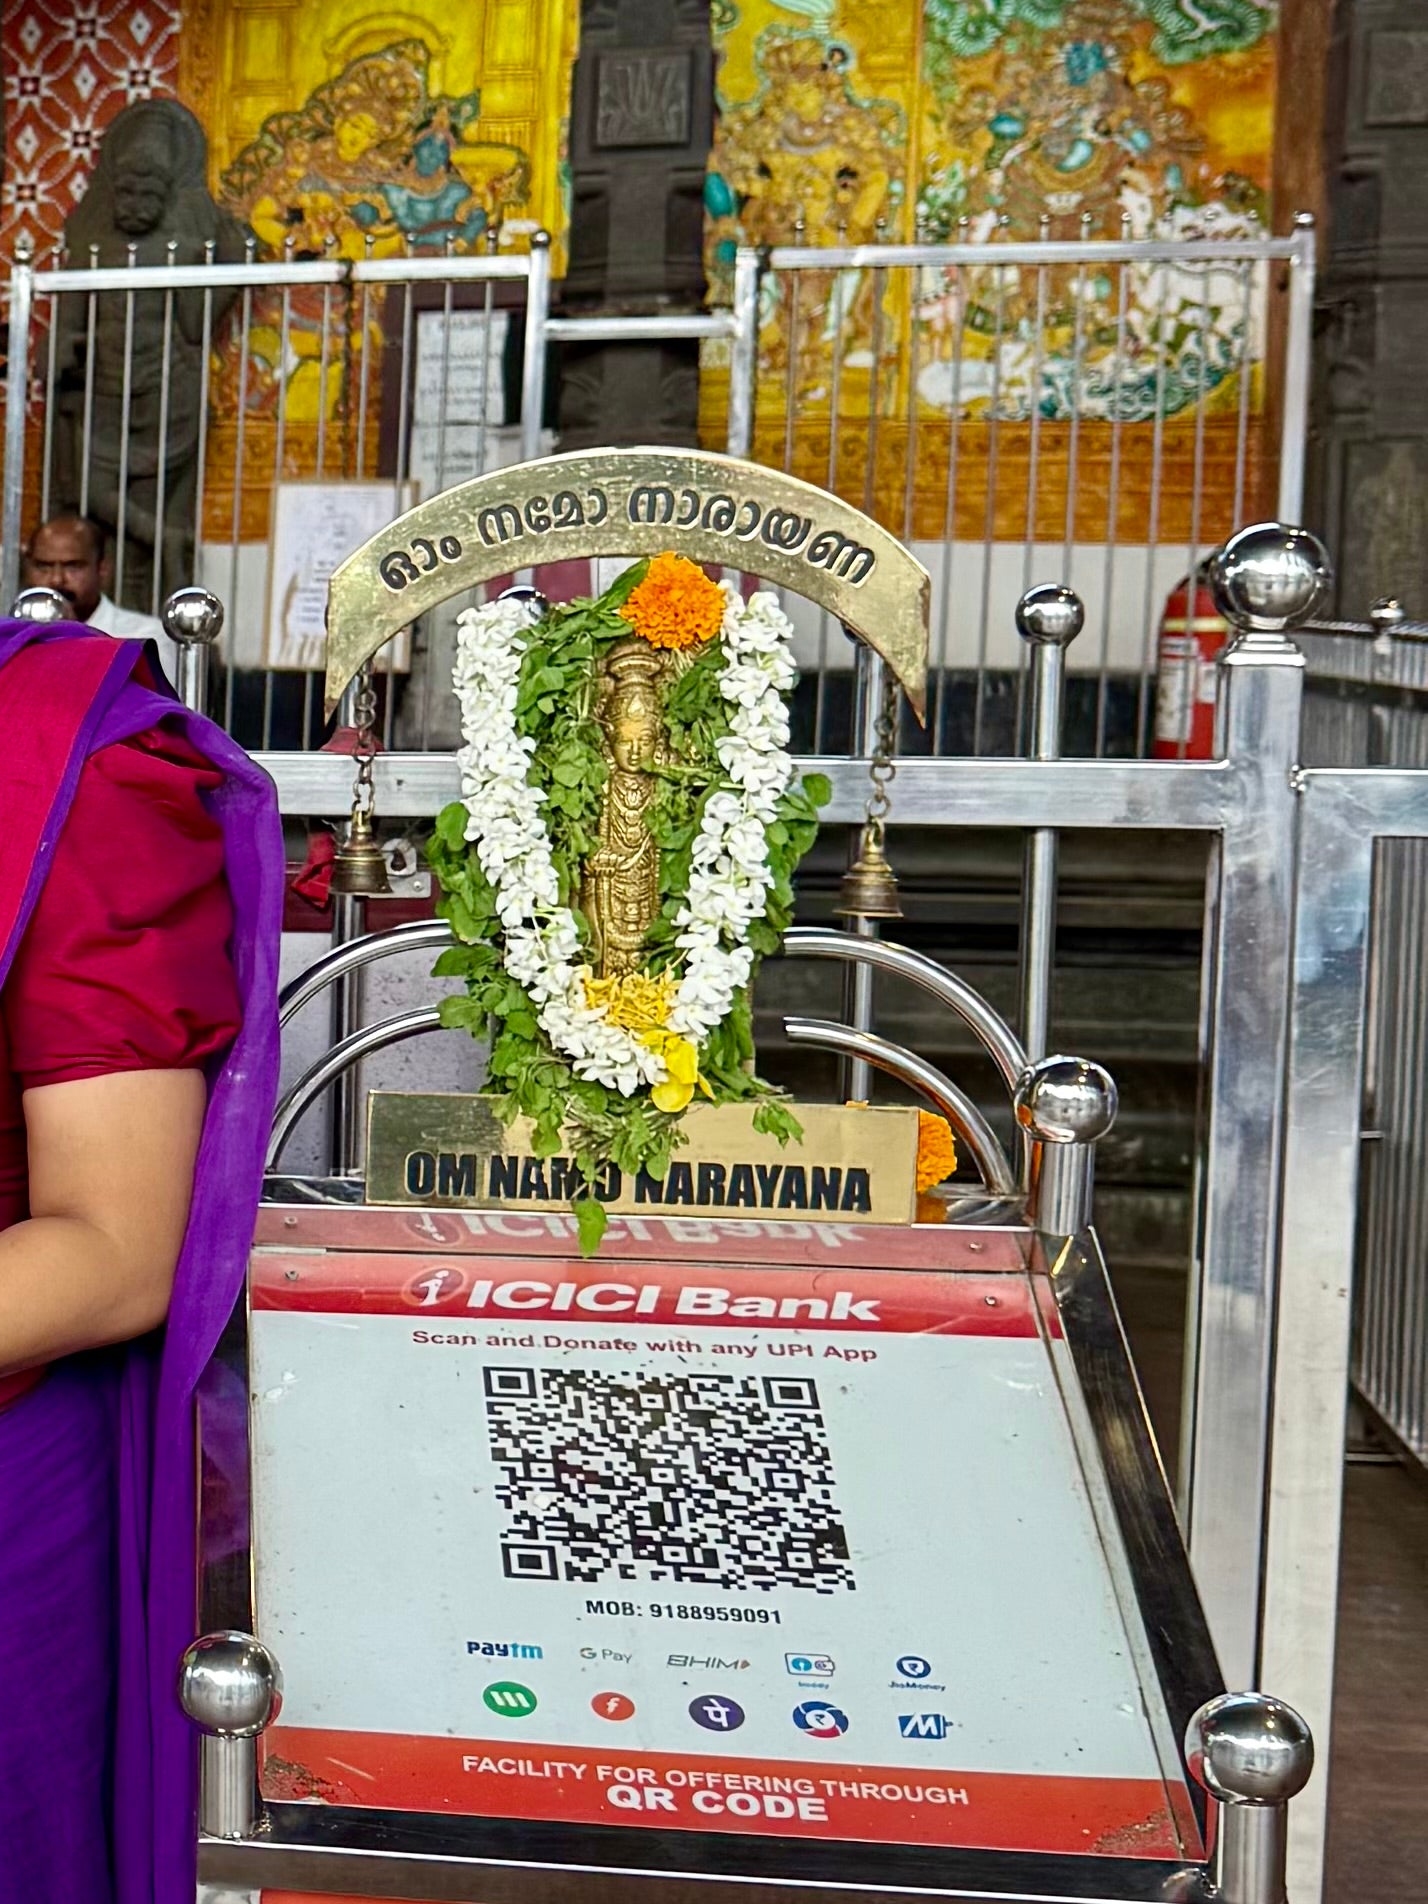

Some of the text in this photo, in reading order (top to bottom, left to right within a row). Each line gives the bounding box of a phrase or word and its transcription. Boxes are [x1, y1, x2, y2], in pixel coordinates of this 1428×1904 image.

[379, 535, 463, 593] ഓം
[478, 488, 608, 548] നമോ
[628, 486, 876, 587] നാരായണ
[405, 1150, 477, 1198] OM
[466, 1279, 660, 1314] ICICI
[675, 1286, 881, 1322] Bank
[413, 1330, 878, 1363] Scan and Donate with any UPI App
[585, 1599, 782, 1625] MOB: 9188959091
[462, 1754, 969, 1806] FACILITY FOR OFFERING THROUGH
[606, 1784, 829, 1823] QR CODE
